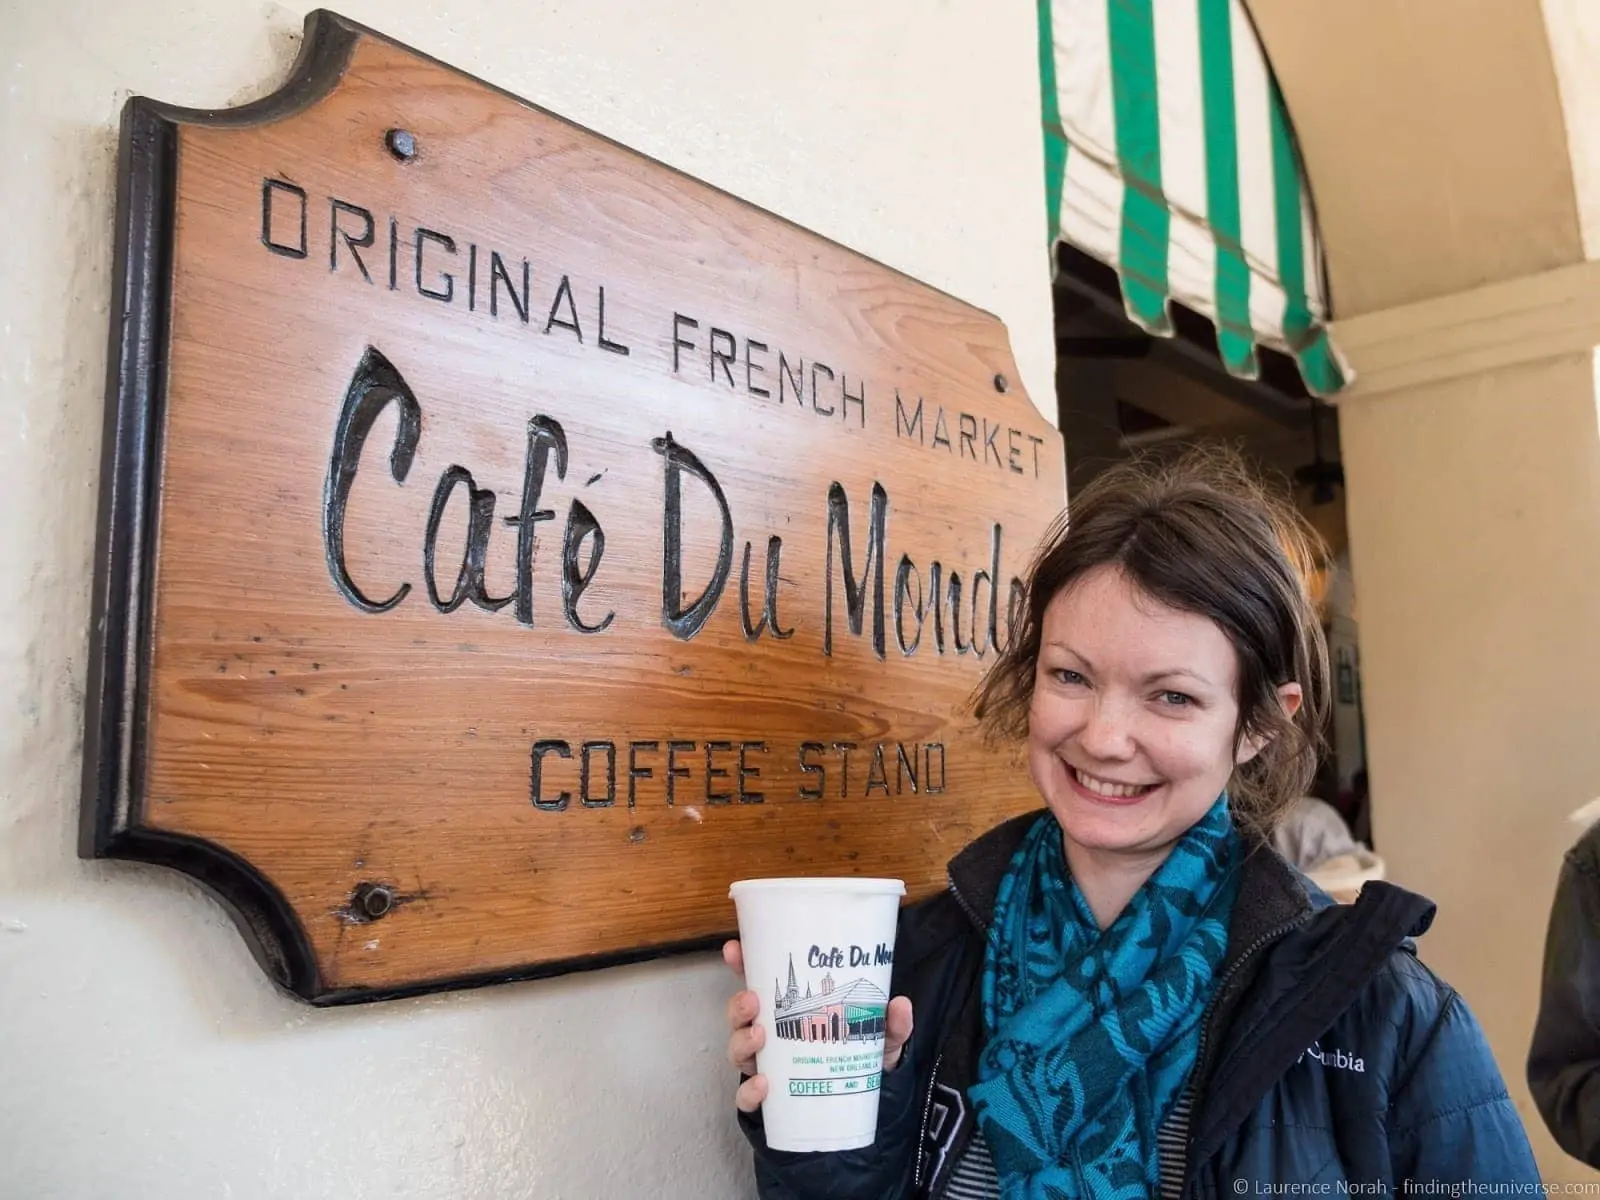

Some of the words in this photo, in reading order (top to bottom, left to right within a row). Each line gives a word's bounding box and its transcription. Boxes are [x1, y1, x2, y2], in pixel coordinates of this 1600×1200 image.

[261, 177, 631, 357] ORIGINAL
[672, 311, 866, 429] FRENCH
[894, 387, 1044, 480] MARKET
[321, 343, 616, 634] Café
[650, 429, 795, 643] Du
[528, 739, 769, 813] COFFEE
[798, 740, 946, 801] STAND
[807, 944, 845, 969] Café
[849, 944, 871, 968] Du
[789, 1081, 833, 1094] COFFEE
